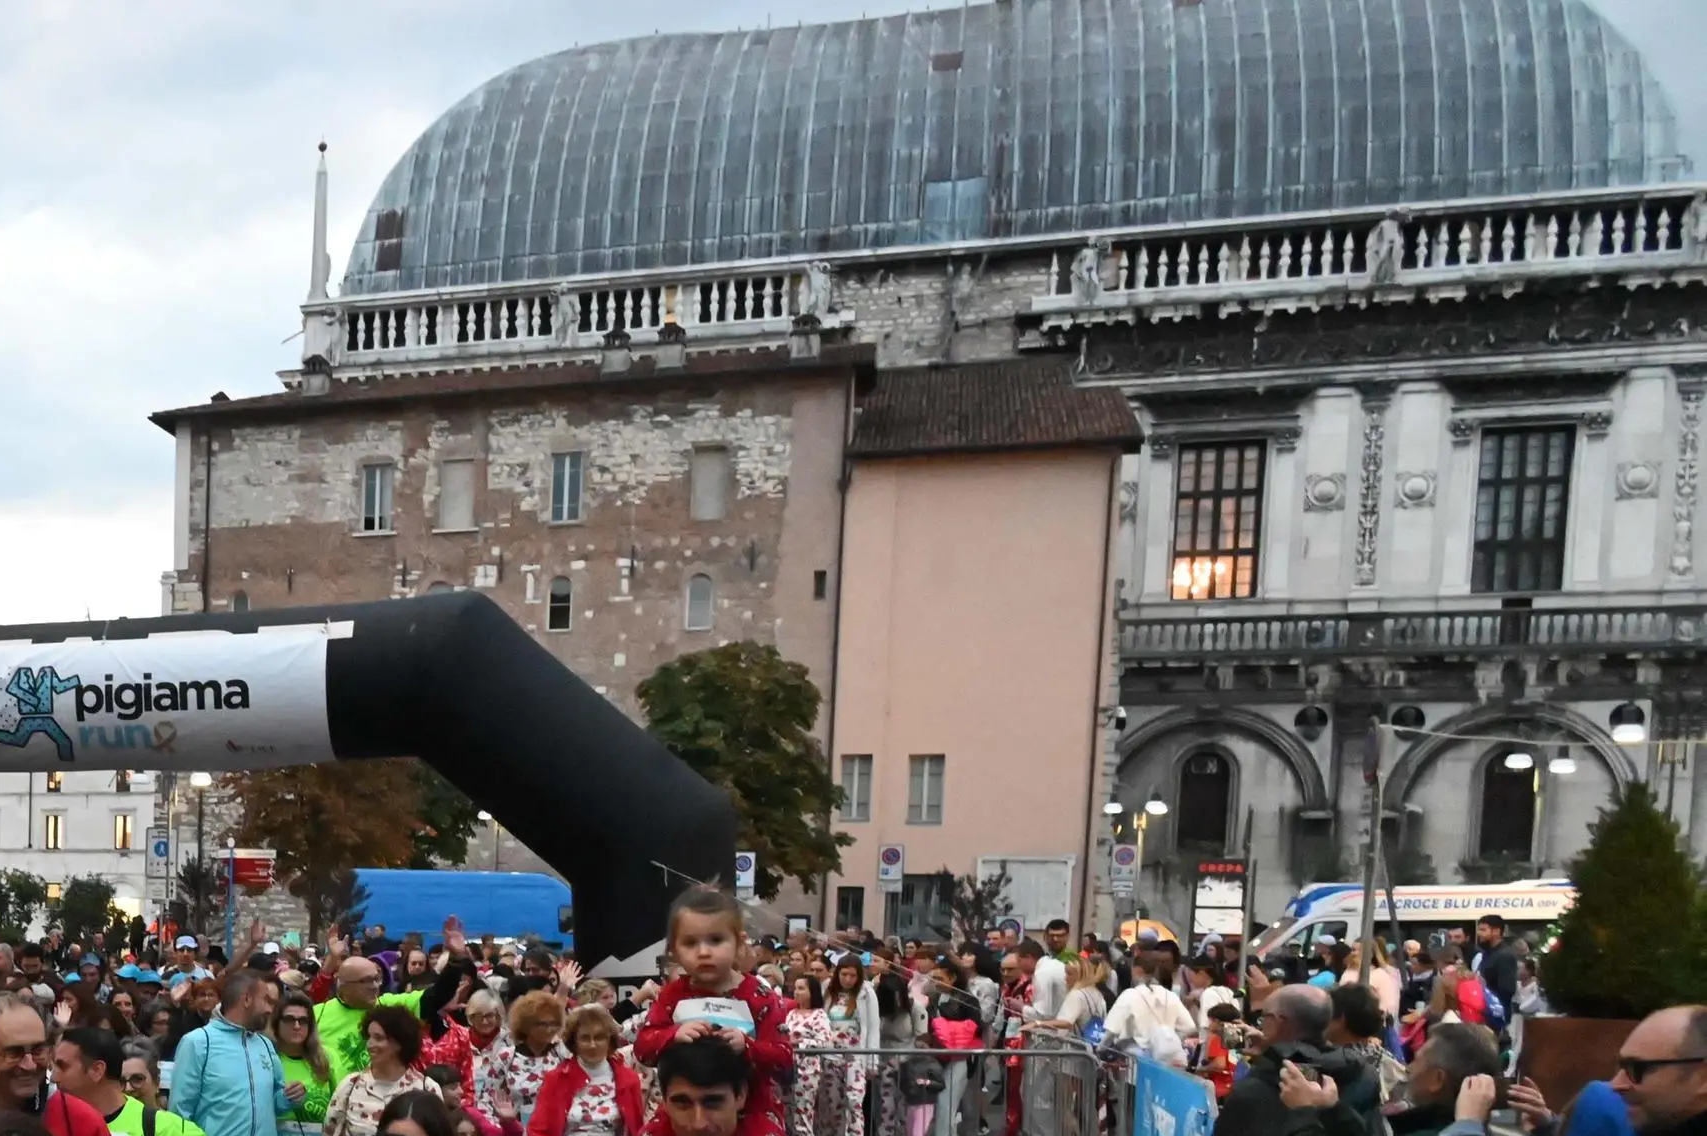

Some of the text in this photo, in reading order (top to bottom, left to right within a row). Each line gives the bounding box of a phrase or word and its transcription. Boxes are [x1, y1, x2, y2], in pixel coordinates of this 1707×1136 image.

[75, 671, 250, 721] pigiama
[79, 723, 151, 750] run
[1393, 898, 1440, 910] CROCE
[1444, 898, 1471, 909] BLU
[1475, 897, 1534, 909] BRESCIA
